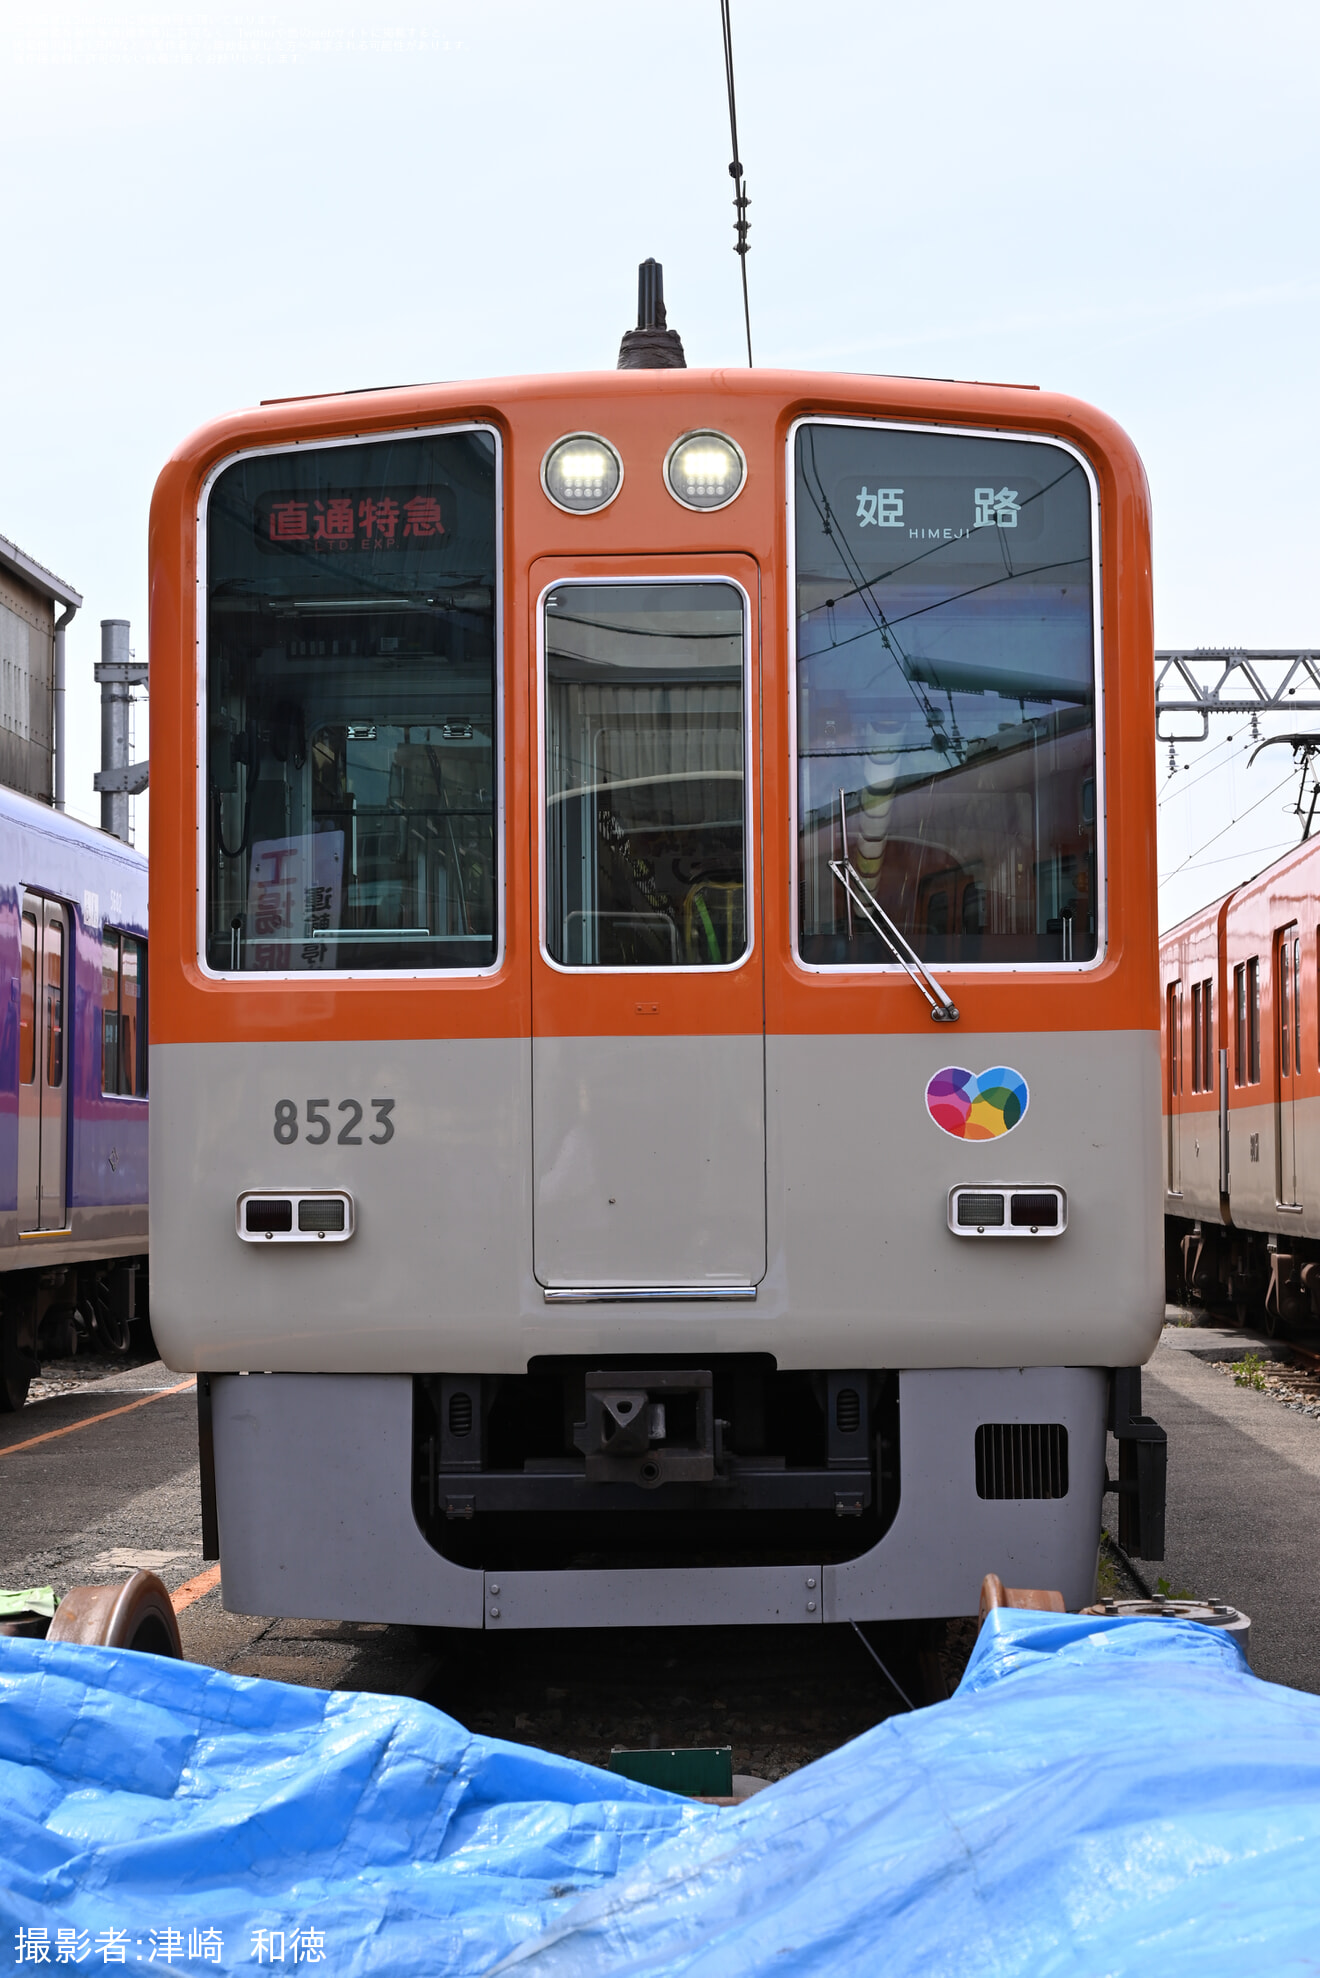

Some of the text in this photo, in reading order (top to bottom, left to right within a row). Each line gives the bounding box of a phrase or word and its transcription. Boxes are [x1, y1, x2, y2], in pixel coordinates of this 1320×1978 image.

[269, 495, 445, 540] 直通特急
[315, 538, 400, 551] LTD. EXP.
[909, 528, 971, 539] HIMEJI
[274, 1099, 395, 1145] 8523
